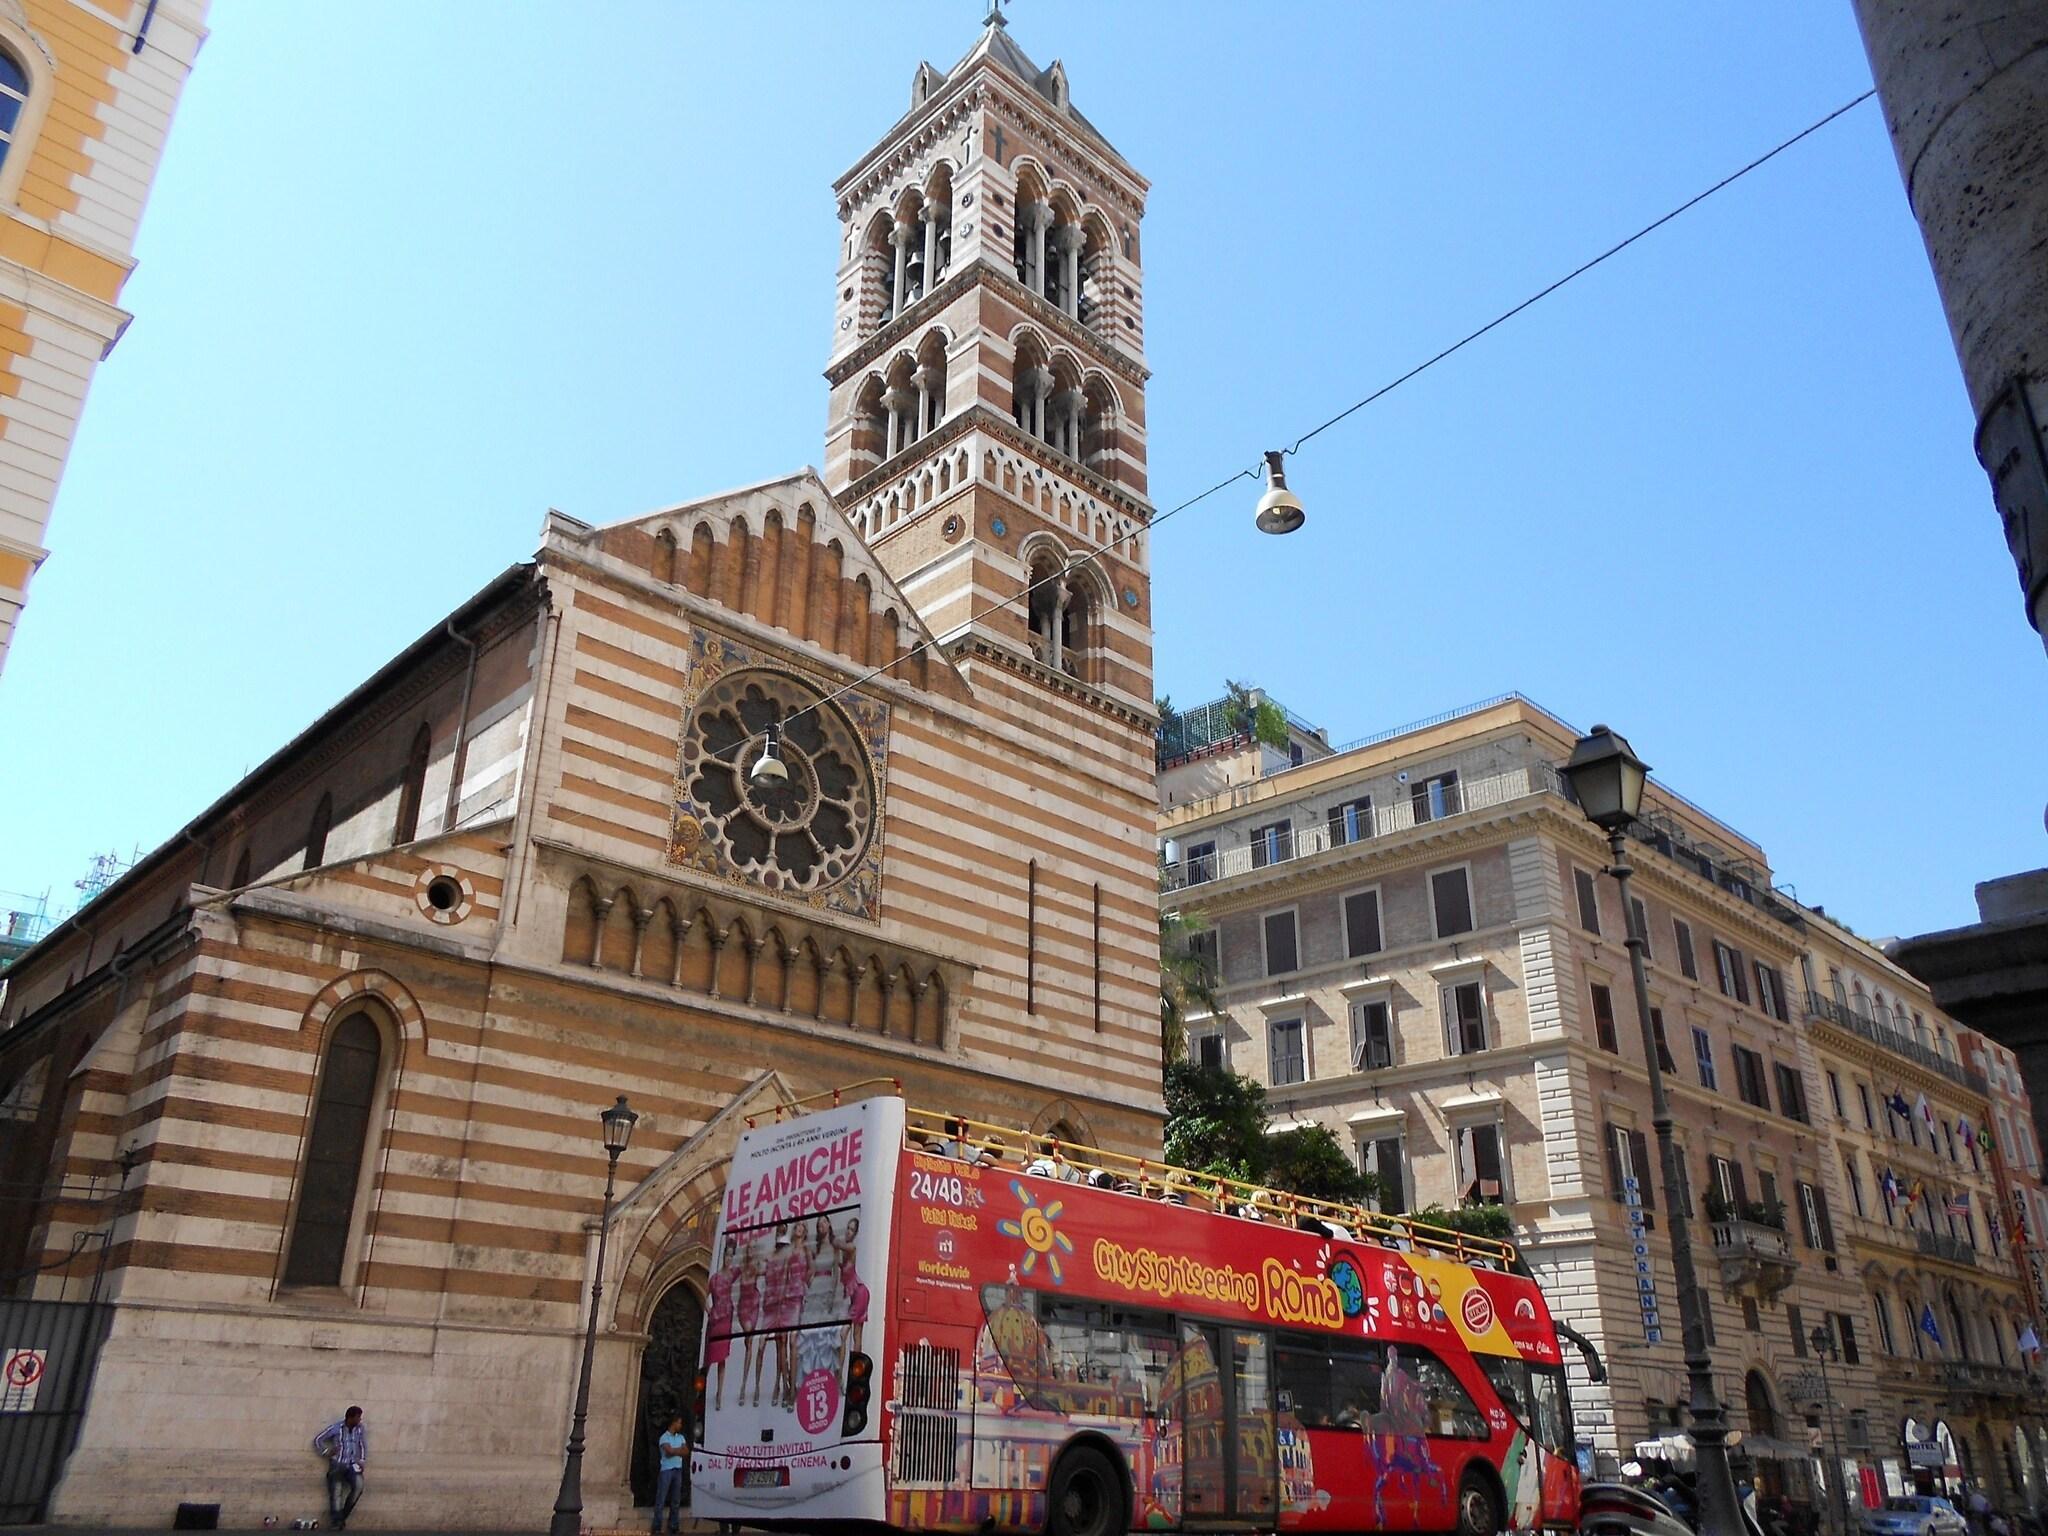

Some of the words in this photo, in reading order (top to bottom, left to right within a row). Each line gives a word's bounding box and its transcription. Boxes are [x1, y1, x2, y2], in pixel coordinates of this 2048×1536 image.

[726, 1181, 752, 1222] LE
[754, 1128, 863, 1209] AMICHE
[910, 1171, 963, 1206] 24/48
[788, 1169, 861, 1219] SPOSA
[1625, 1178, 1659, 1343] RISTORANTE
[807, 1390, 828, 1422] 13
[708, 1458, 721, 1469] DAL
[724, 1457, 733, 1470] 19
[791, 1455, 828, 1468] CINEMA
[727, 1445, 751, 1456] SIAMO
[752, 1445, 776, 1456] TUTTI
[777, 1441, 813, 1454] INVITATI
[1908, 1442, 1936, 1450] HOTEL
